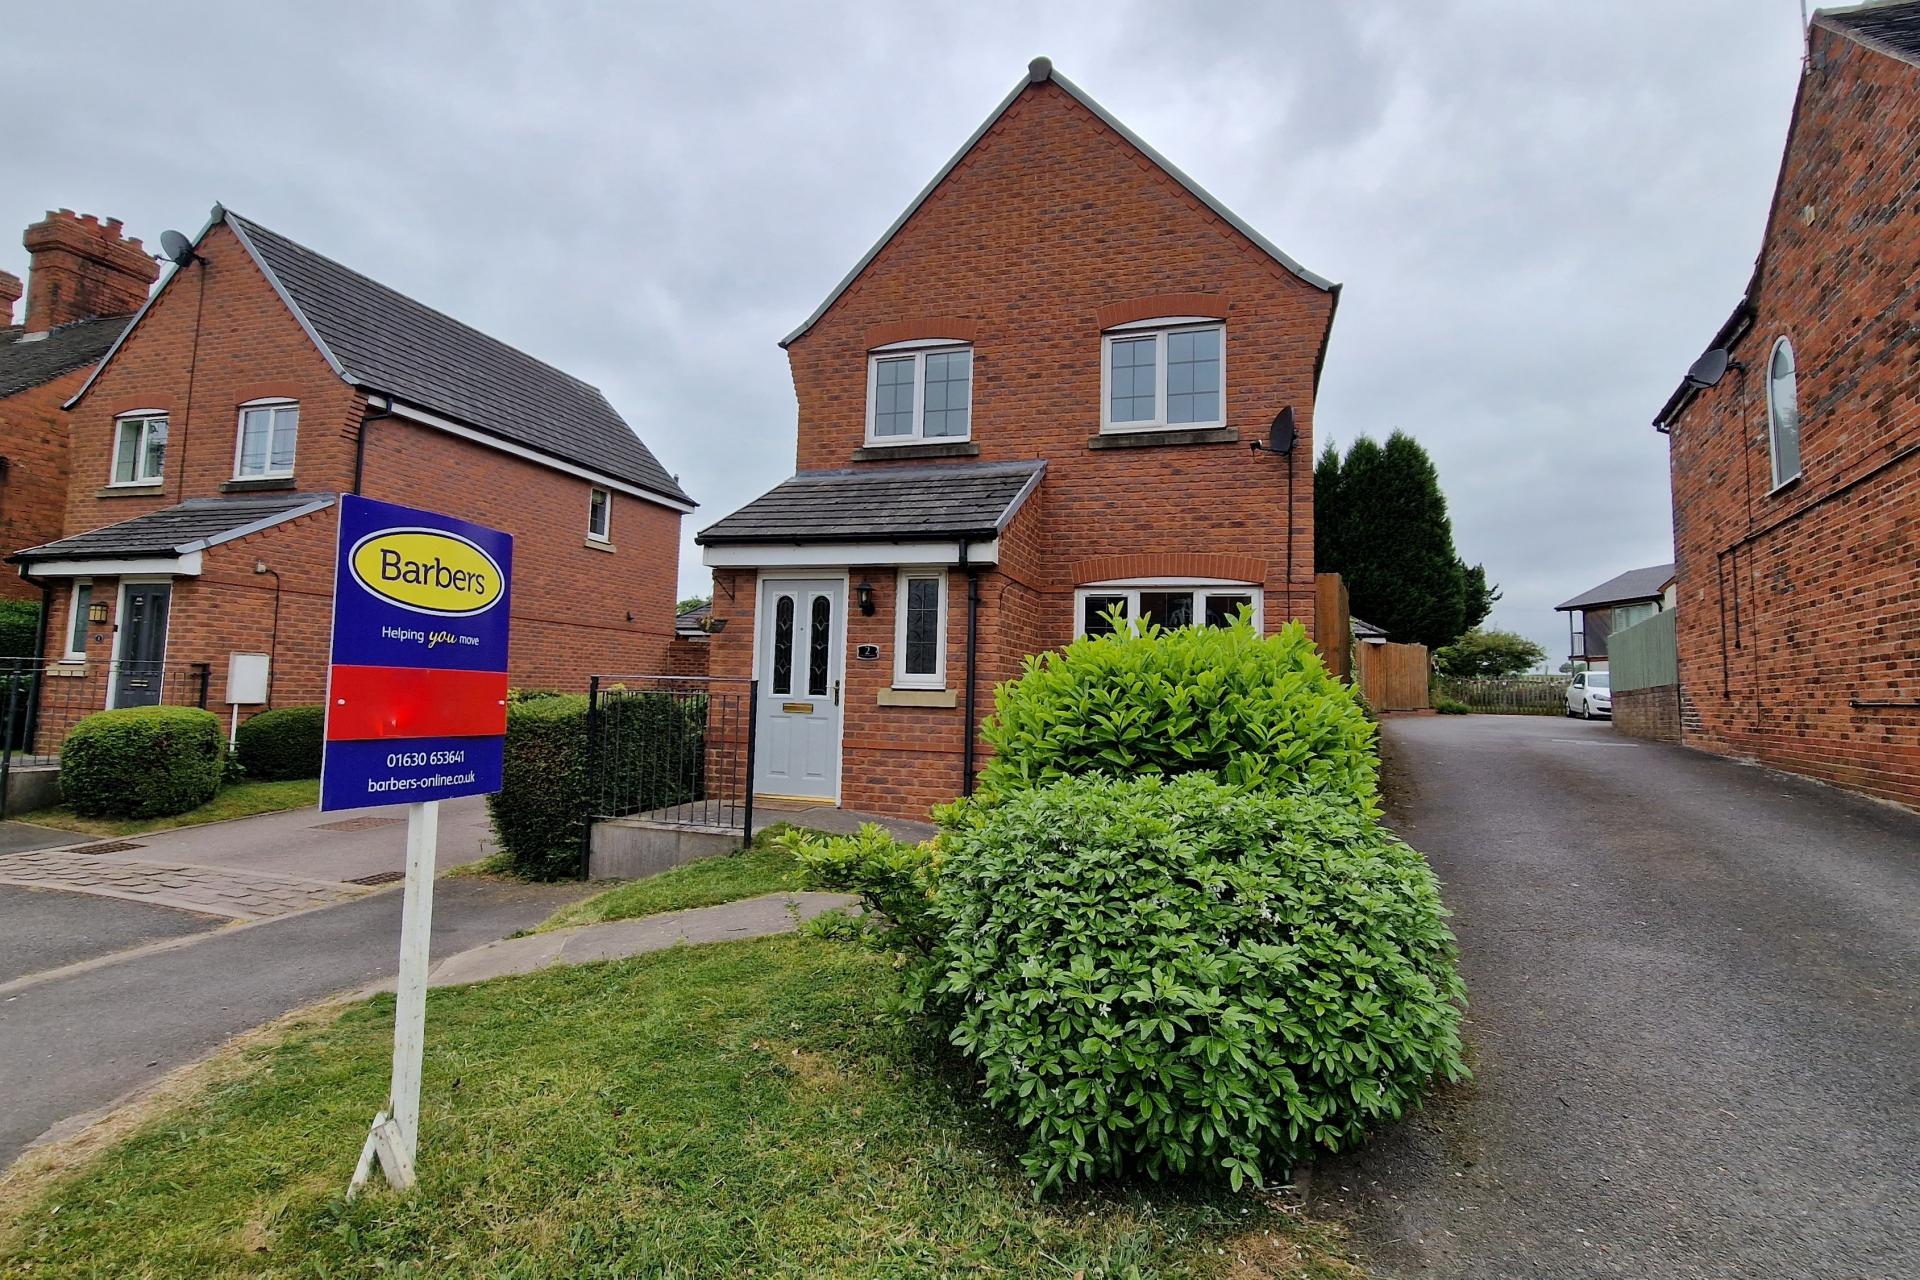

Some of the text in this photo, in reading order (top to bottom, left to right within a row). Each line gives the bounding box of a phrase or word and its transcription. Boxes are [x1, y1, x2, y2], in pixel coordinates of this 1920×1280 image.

[380, 548, 485, 595] Barbers
[382, 626, 480, 649] Helping you move
[387, 750, 464, 768] 01630 653641
[368, 770, 475, 792] barbers-online.co.uk
